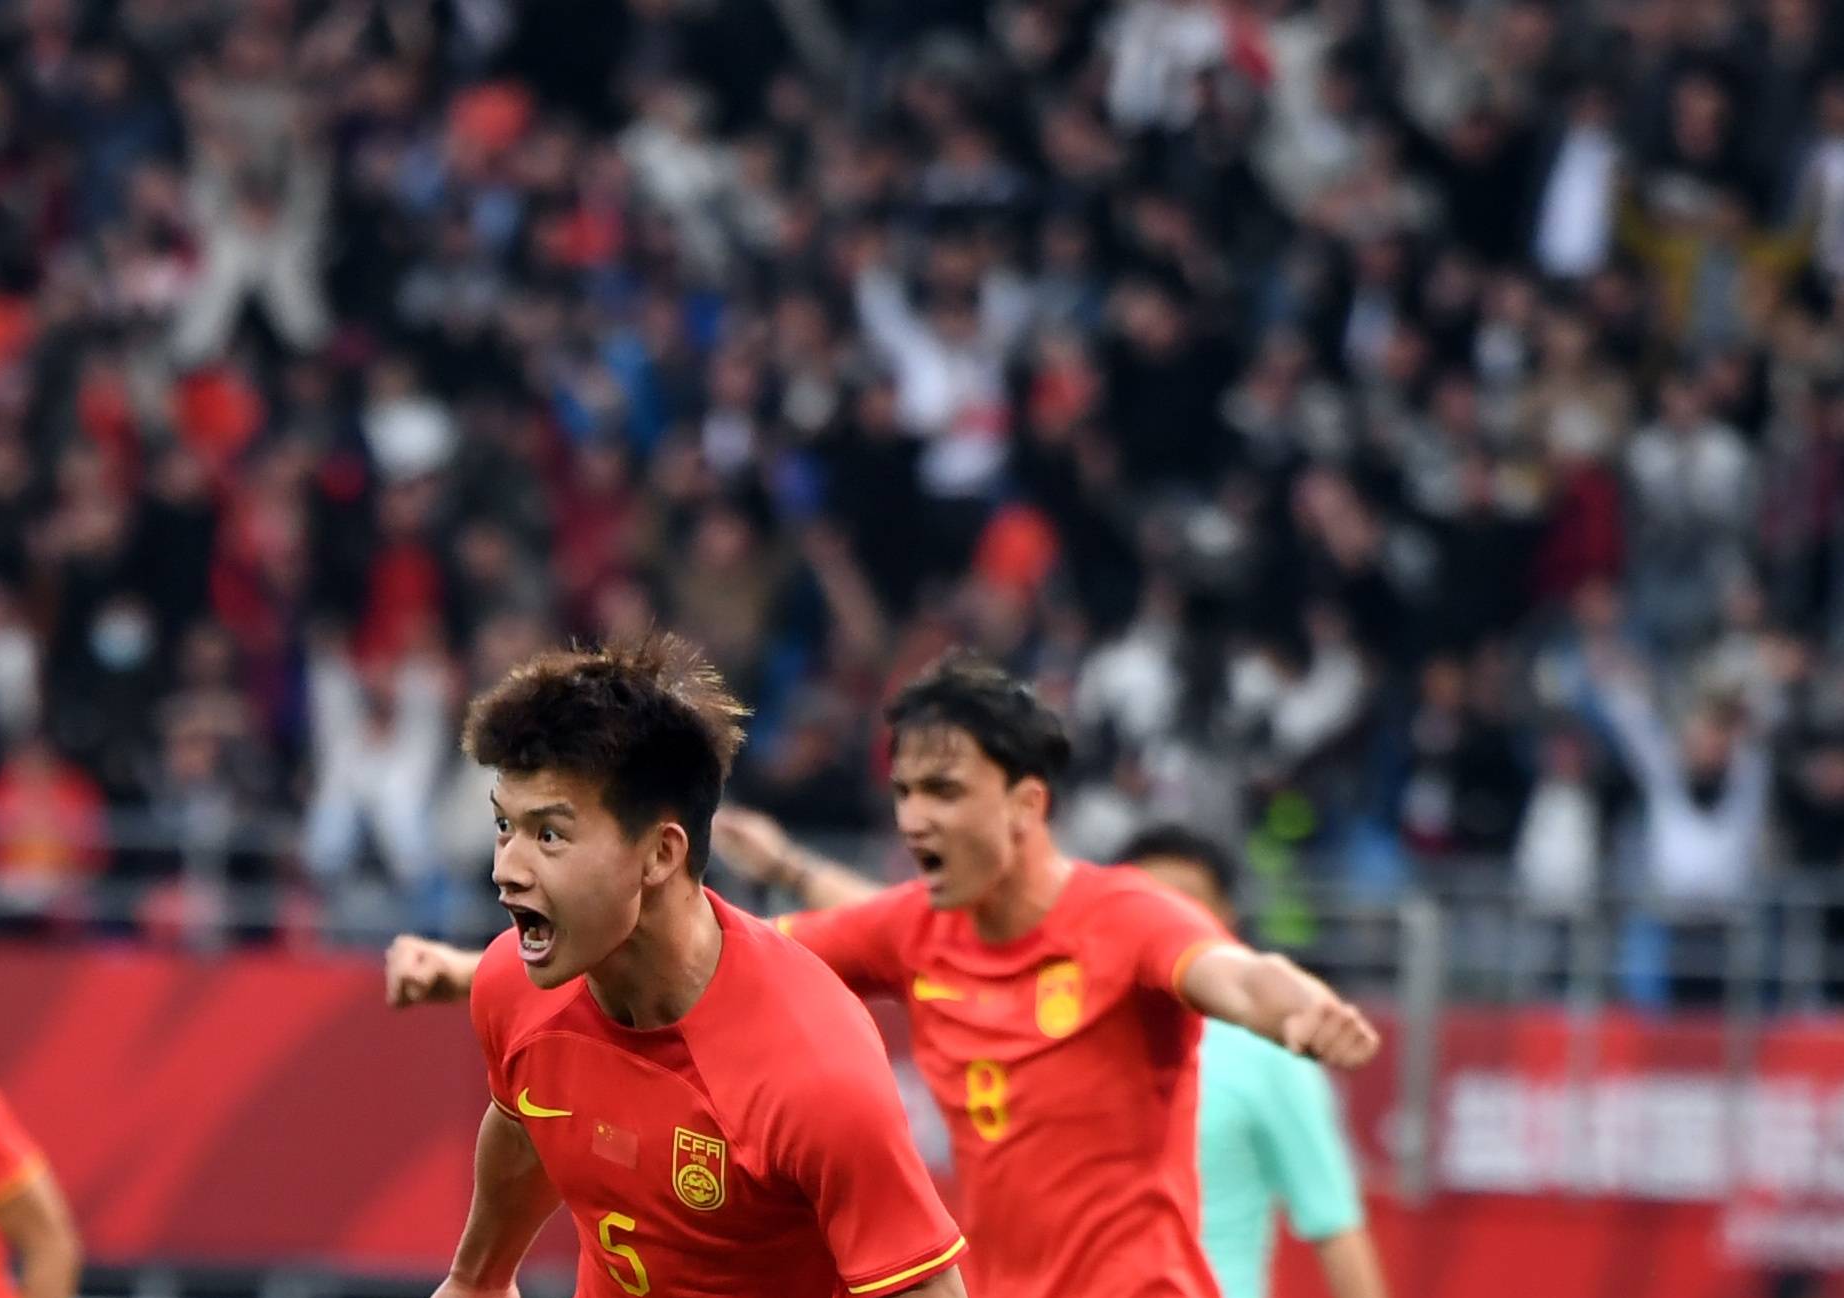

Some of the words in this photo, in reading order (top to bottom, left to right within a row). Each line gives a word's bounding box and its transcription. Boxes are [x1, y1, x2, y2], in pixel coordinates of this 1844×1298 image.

[966, 1059, 1008, 1142] 8
[679, 1134, 720, 1159] CFA
[599, 1211, 650, 1297] 5
